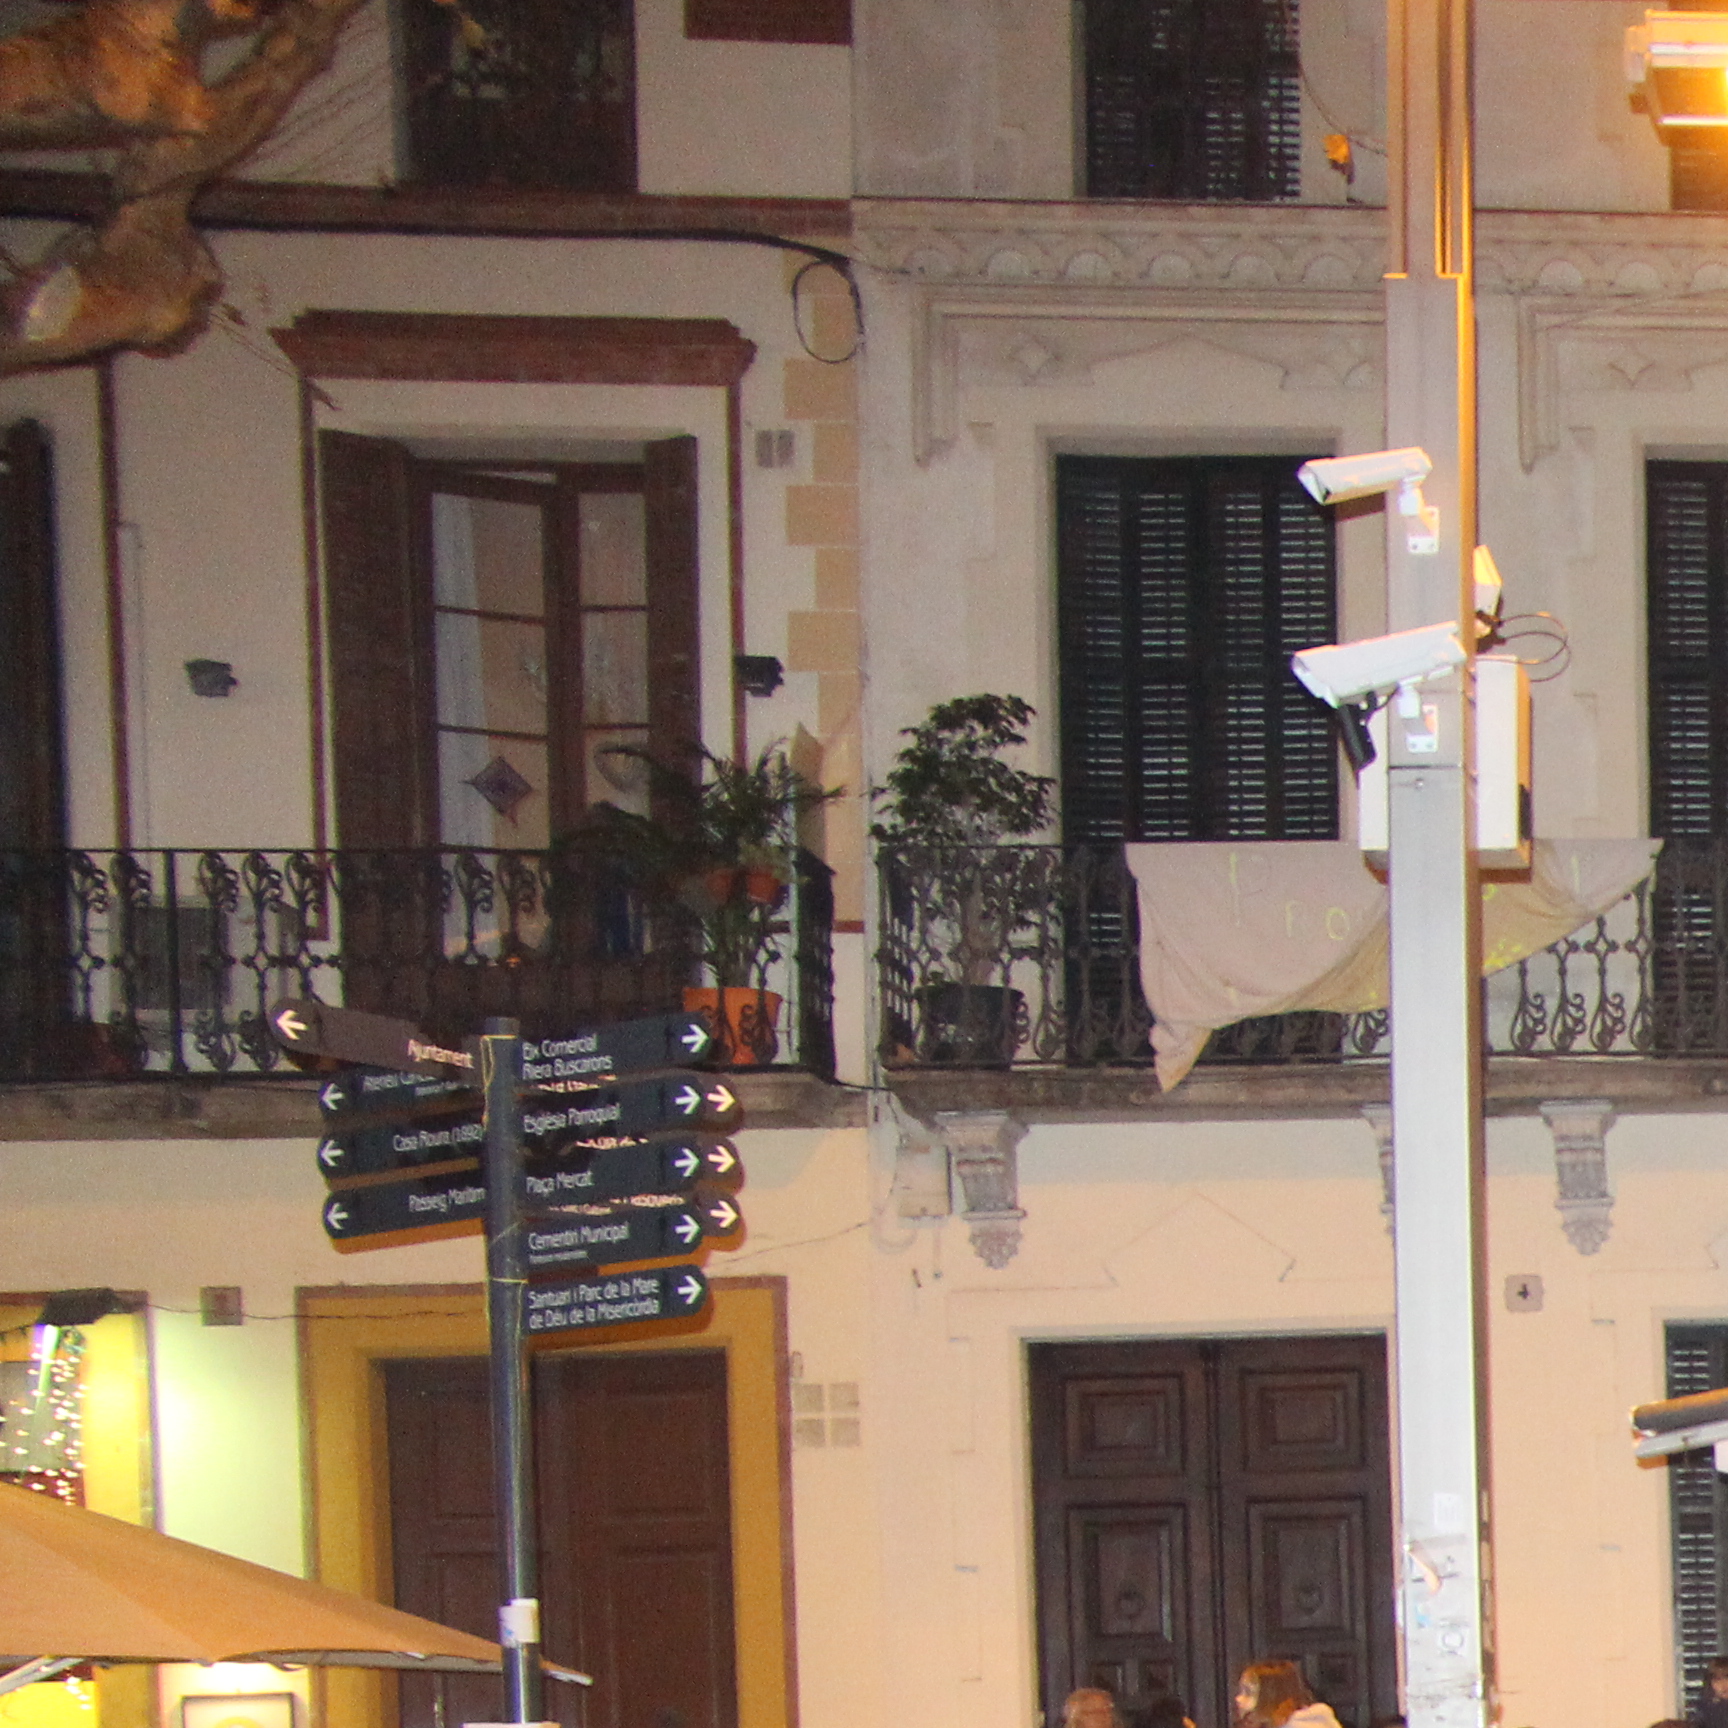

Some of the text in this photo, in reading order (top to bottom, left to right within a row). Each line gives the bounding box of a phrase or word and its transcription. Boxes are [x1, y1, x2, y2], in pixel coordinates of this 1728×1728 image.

[407, 1038, 475, 1069] Ajuntament
[541, 1033, 598, 1058] Comercial
[522, 1054, 613, 1081] Riera Buscarons
[568, 1102, 621, 1127] Parroquial
[393, 1134, 419, 1153] Casa
[420, 1129, 451, 1151] Roura
[526, 1169, 594, 1197] Plaça Mercat
[408, 1191, 448, 1213] Passeig
[528, 1221, 630, 1251] Cementiri Municipal
[528, 1286, 571, 1309] Santuari
[579, 1283, 602, 1302] Parc
[603, 1280, 620, 1299] de
[622, 1280, 632, 1297] la
[633, 1277, 660, 1295] Mare
[529, 1312, 543, 1329] de
[545, 1308, 567, 1328] Déu
[569, 1305, 584, 1324] de
[586, 1304, 596, 1322] la
